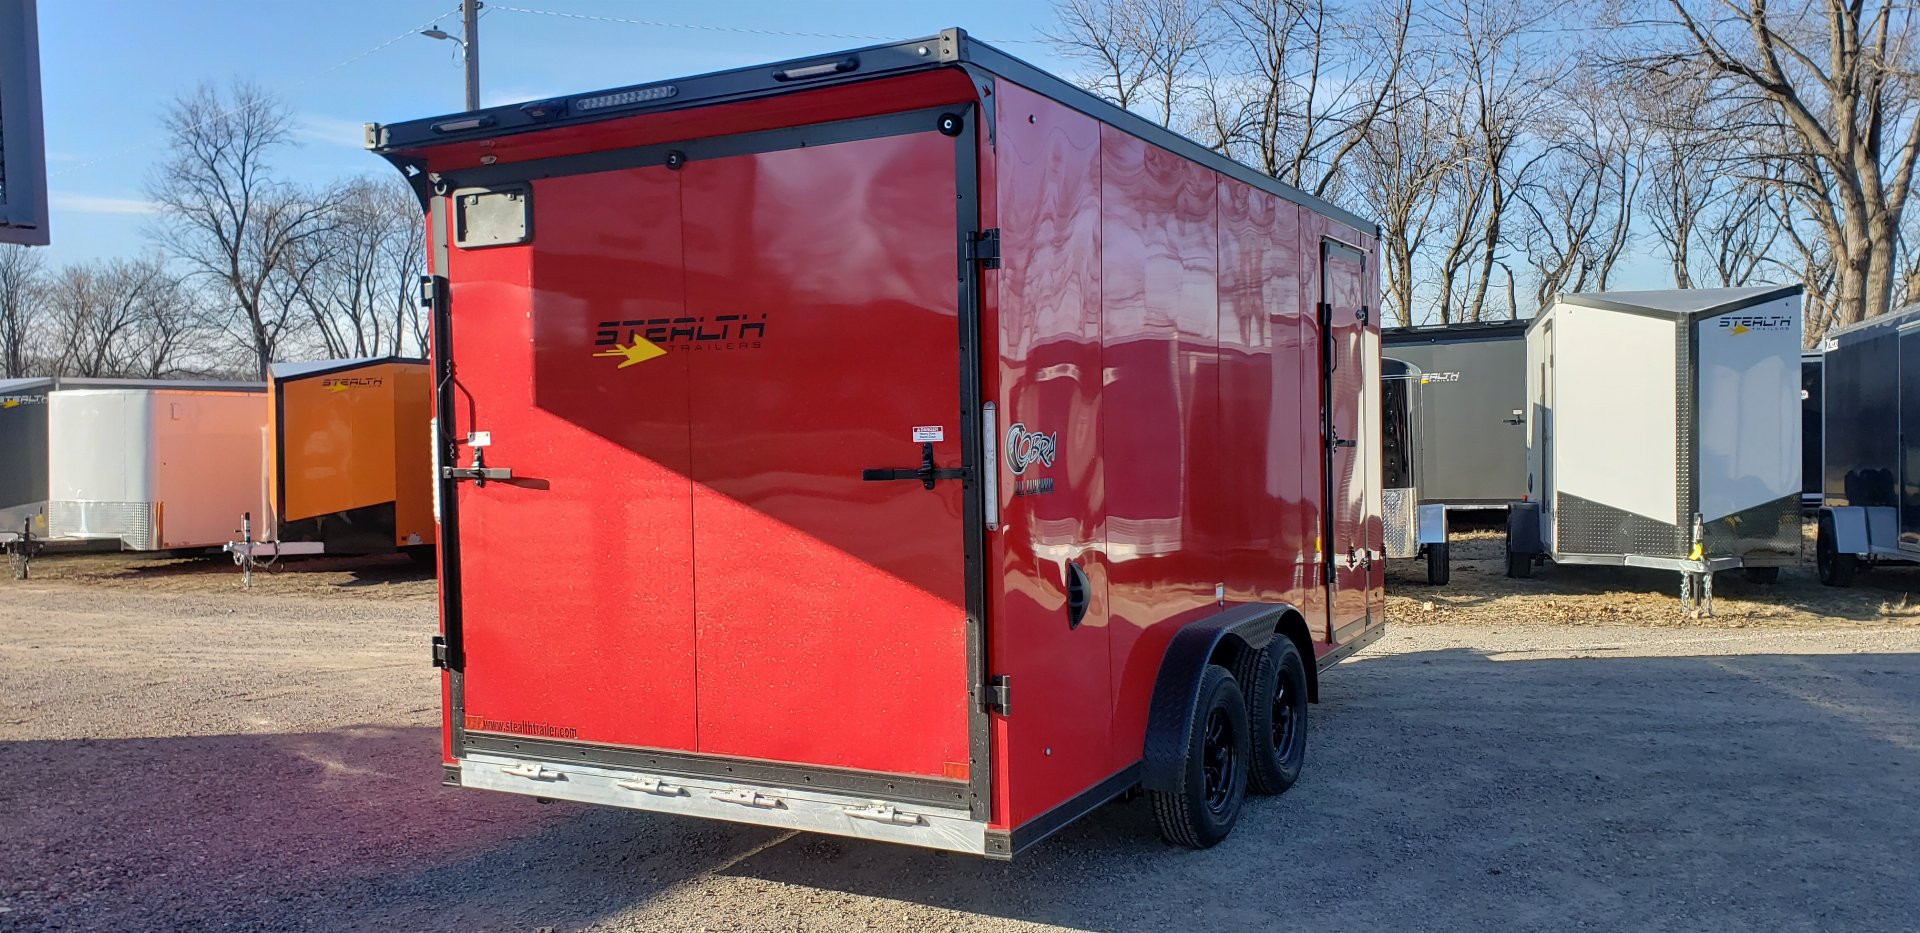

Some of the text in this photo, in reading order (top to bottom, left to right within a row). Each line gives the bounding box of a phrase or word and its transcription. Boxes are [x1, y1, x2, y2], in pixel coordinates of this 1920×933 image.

[1719, 316, 1792, 328] STEALTH
[594, 313, 767, 346] STEALTH
[668, 341, 762, 352] TRAILERS
[323, 377, 383, 387] STEALTH
[1421, 371, 1460, 381] EALTH
[1005, 423, 1057, 475] COBRA
[483, 719, 577, 738] www.stealthtrailer.com
